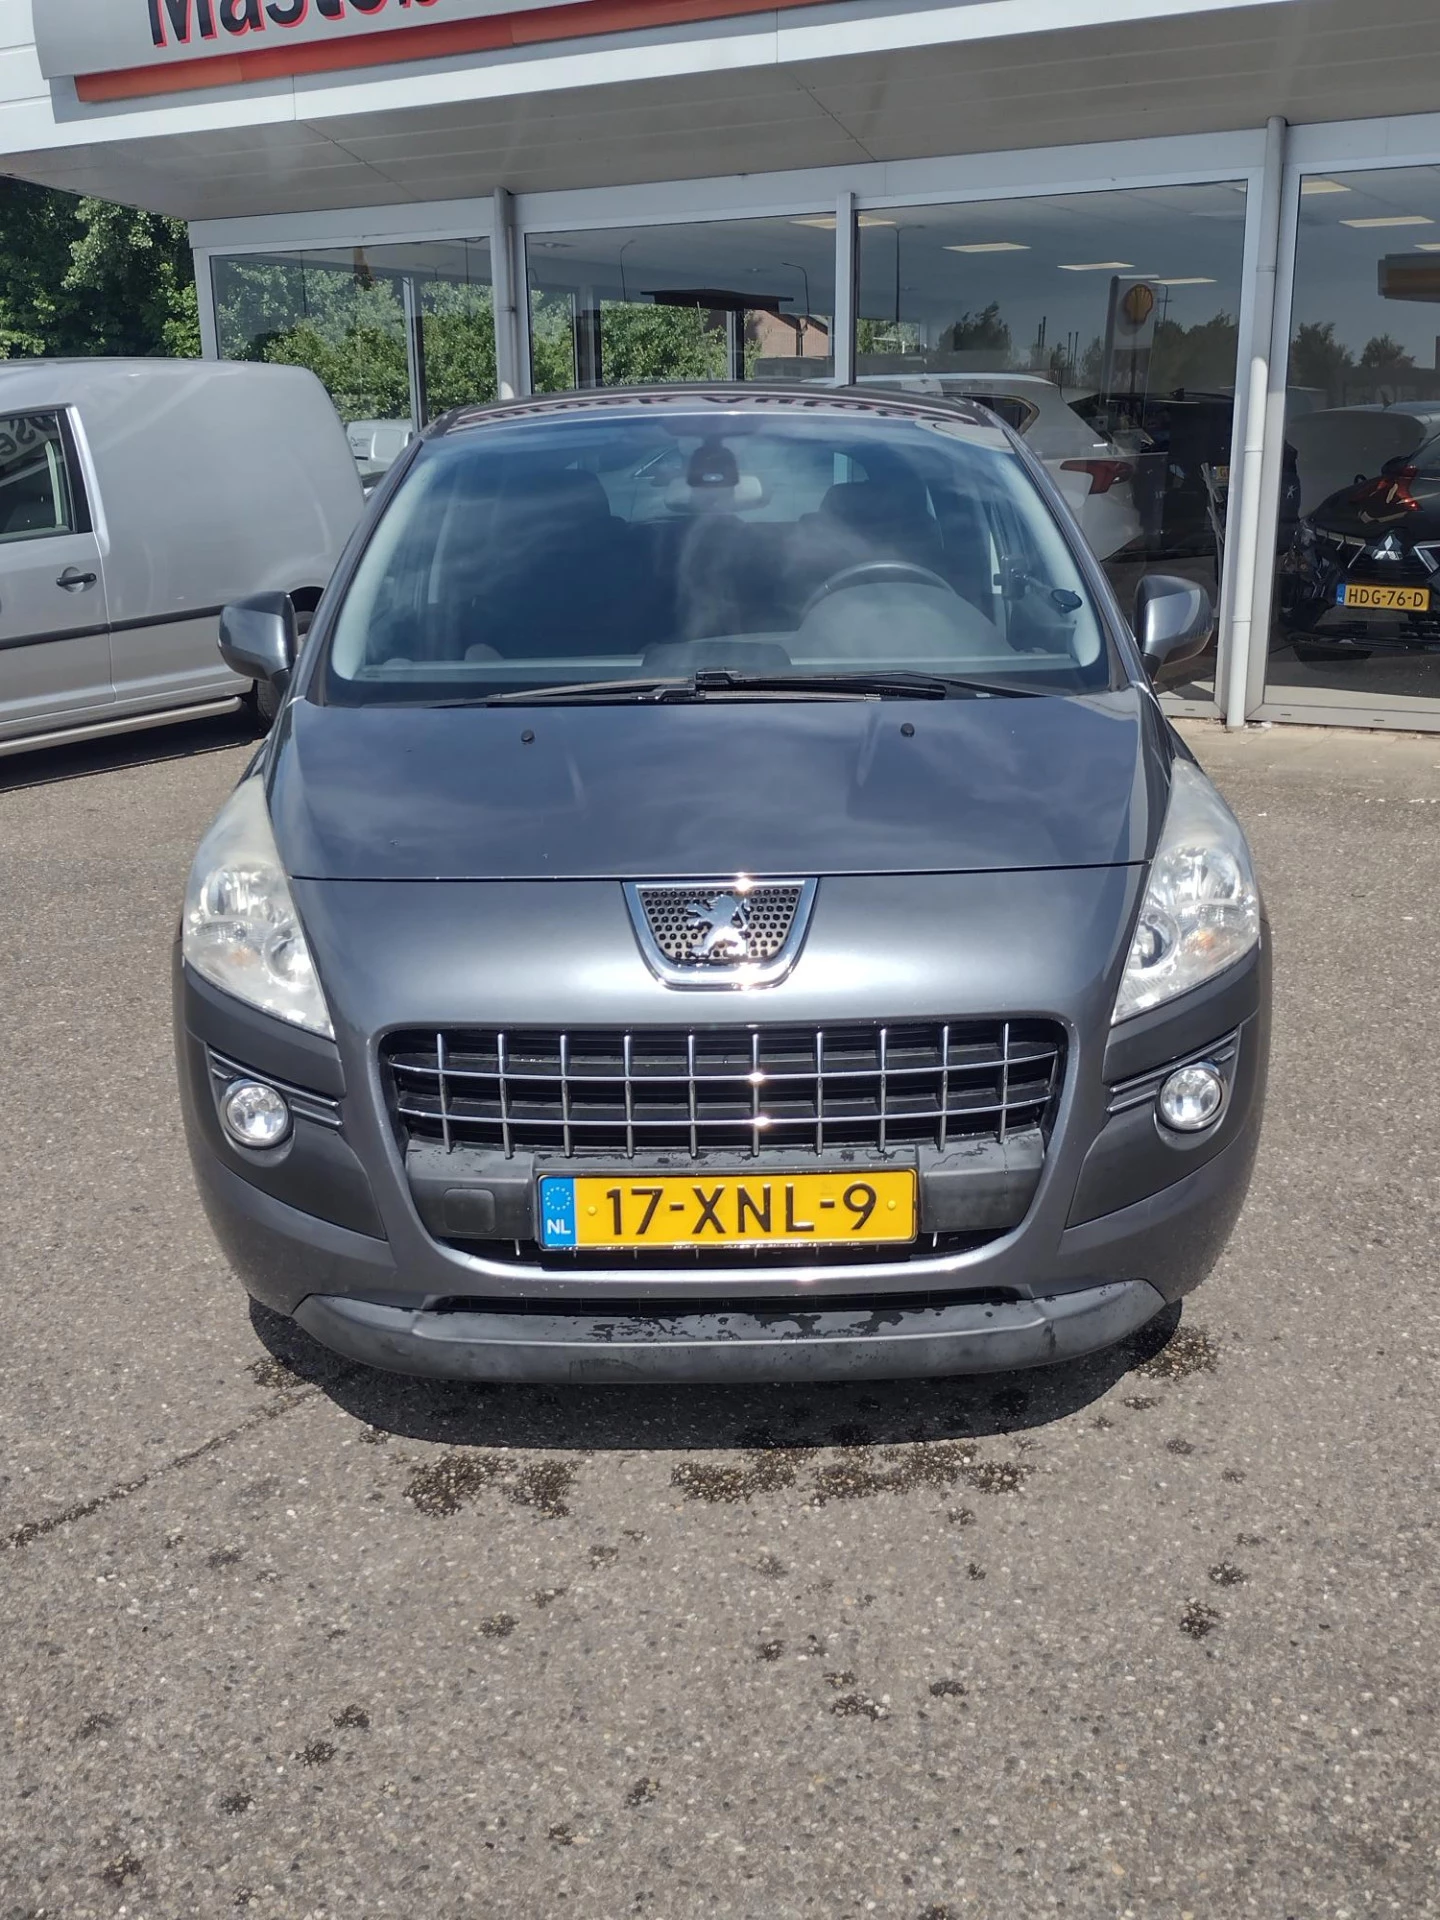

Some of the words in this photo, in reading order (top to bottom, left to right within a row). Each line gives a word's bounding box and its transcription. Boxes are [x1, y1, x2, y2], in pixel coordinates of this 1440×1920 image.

[1348, 588, 1424, 607] HDG-76-D
[605, 1180, 878, 1236] 17-XNL-9
[546, 1218, 572, 1235] NL
